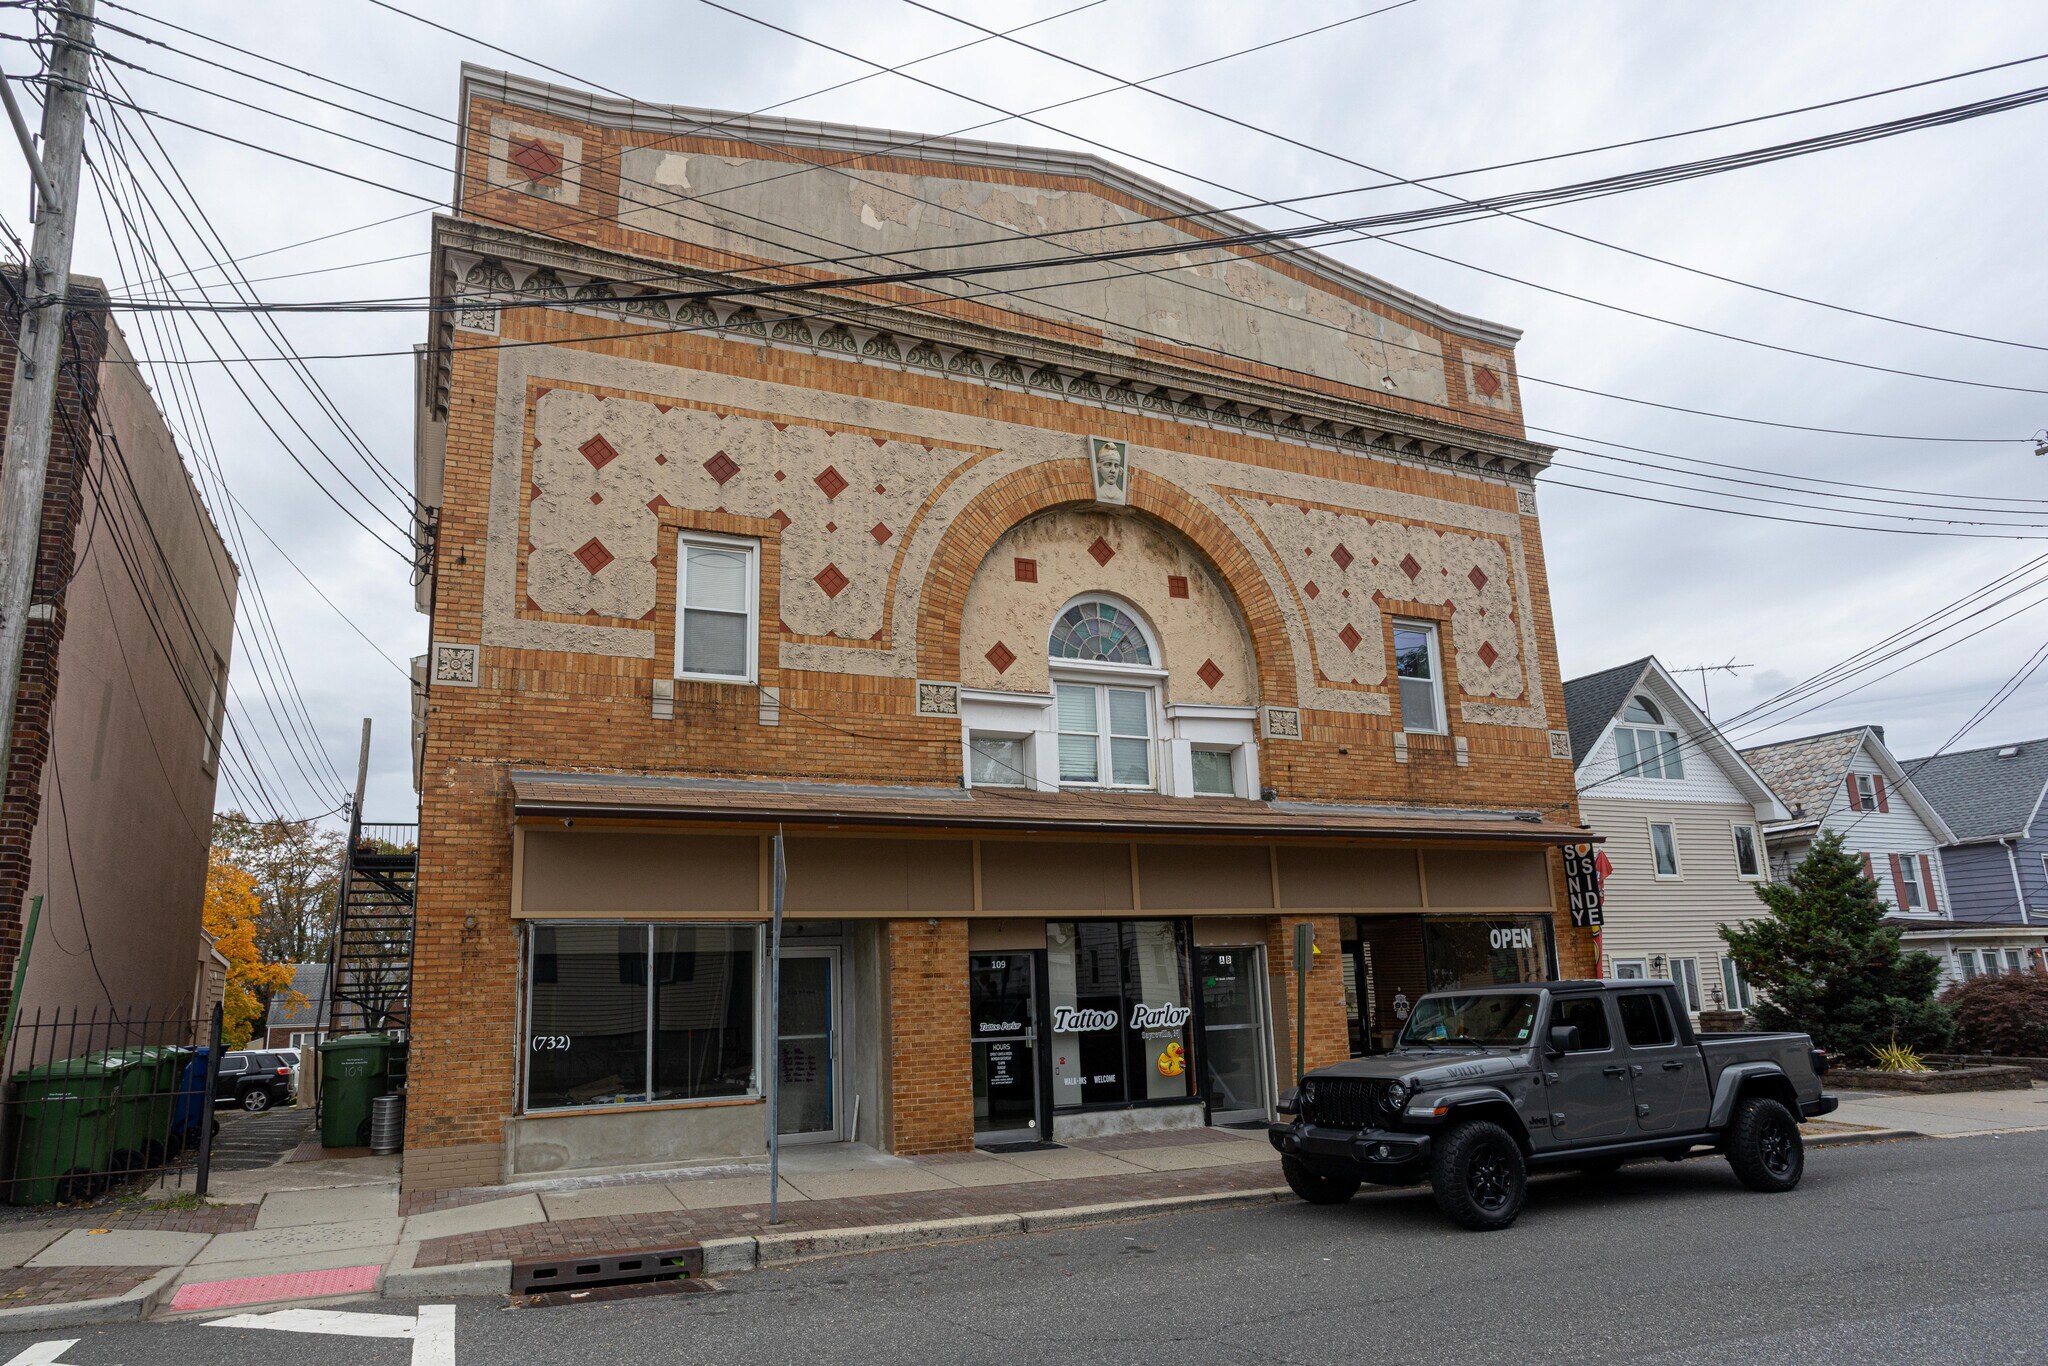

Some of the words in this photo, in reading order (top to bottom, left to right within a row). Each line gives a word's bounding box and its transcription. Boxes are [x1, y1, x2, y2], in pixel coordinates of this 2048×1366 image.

[1564, 845, 1584, 926] SUNNY
[1581, 858, 1600, 925] SIDE
[1490, 928, 1532, 949] OPEN
[1054, 1007, 1117, 1031] Tattoo
[1131, 1003, 1189, 1027] Parlor
[533, 1035, 570, 1051] (732)
[345, 1066, 363, 1077] 109
[1064, 1077, 1087, 1085] WALK-INS
[1094, 1074, 1116, 1083] WELCOME
[1447, 1065, 1485, 1077] WILLYS
